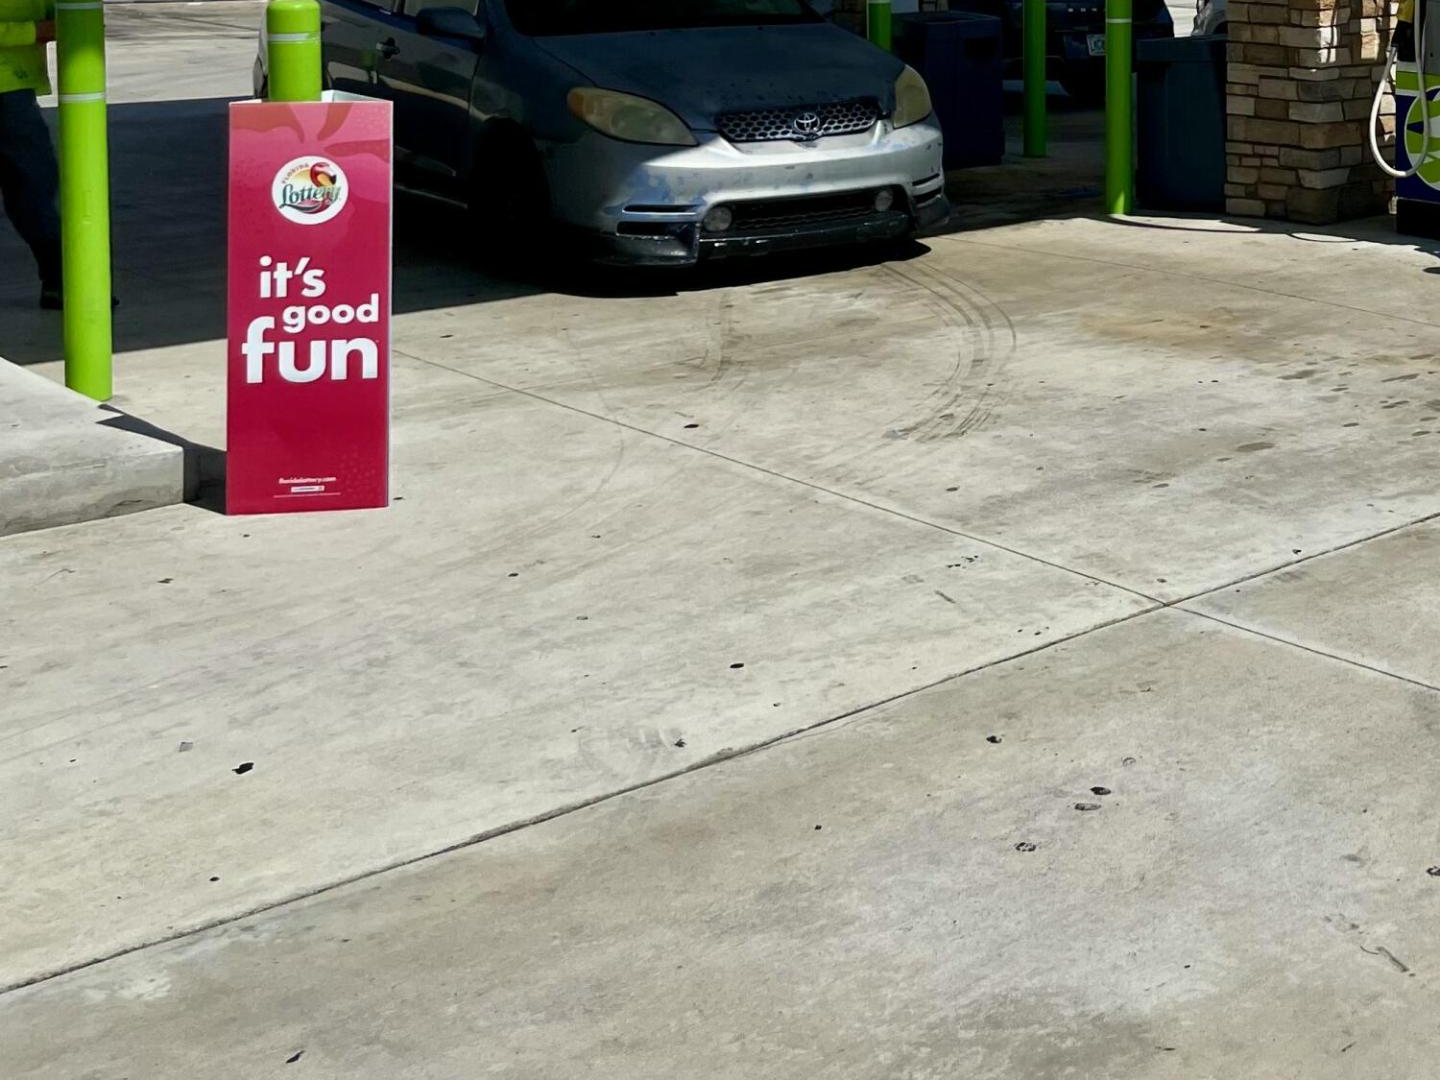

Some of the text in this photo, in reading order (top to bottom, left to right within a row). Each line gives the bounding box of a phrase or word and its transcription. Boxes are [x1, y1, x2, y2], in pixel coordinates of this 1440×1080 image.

[279, 183, 342, 210] Lottery
[259, 255, 326, 298] it's
[282, 293, 380, 333] good
[241, 316, 379, 384] fun
